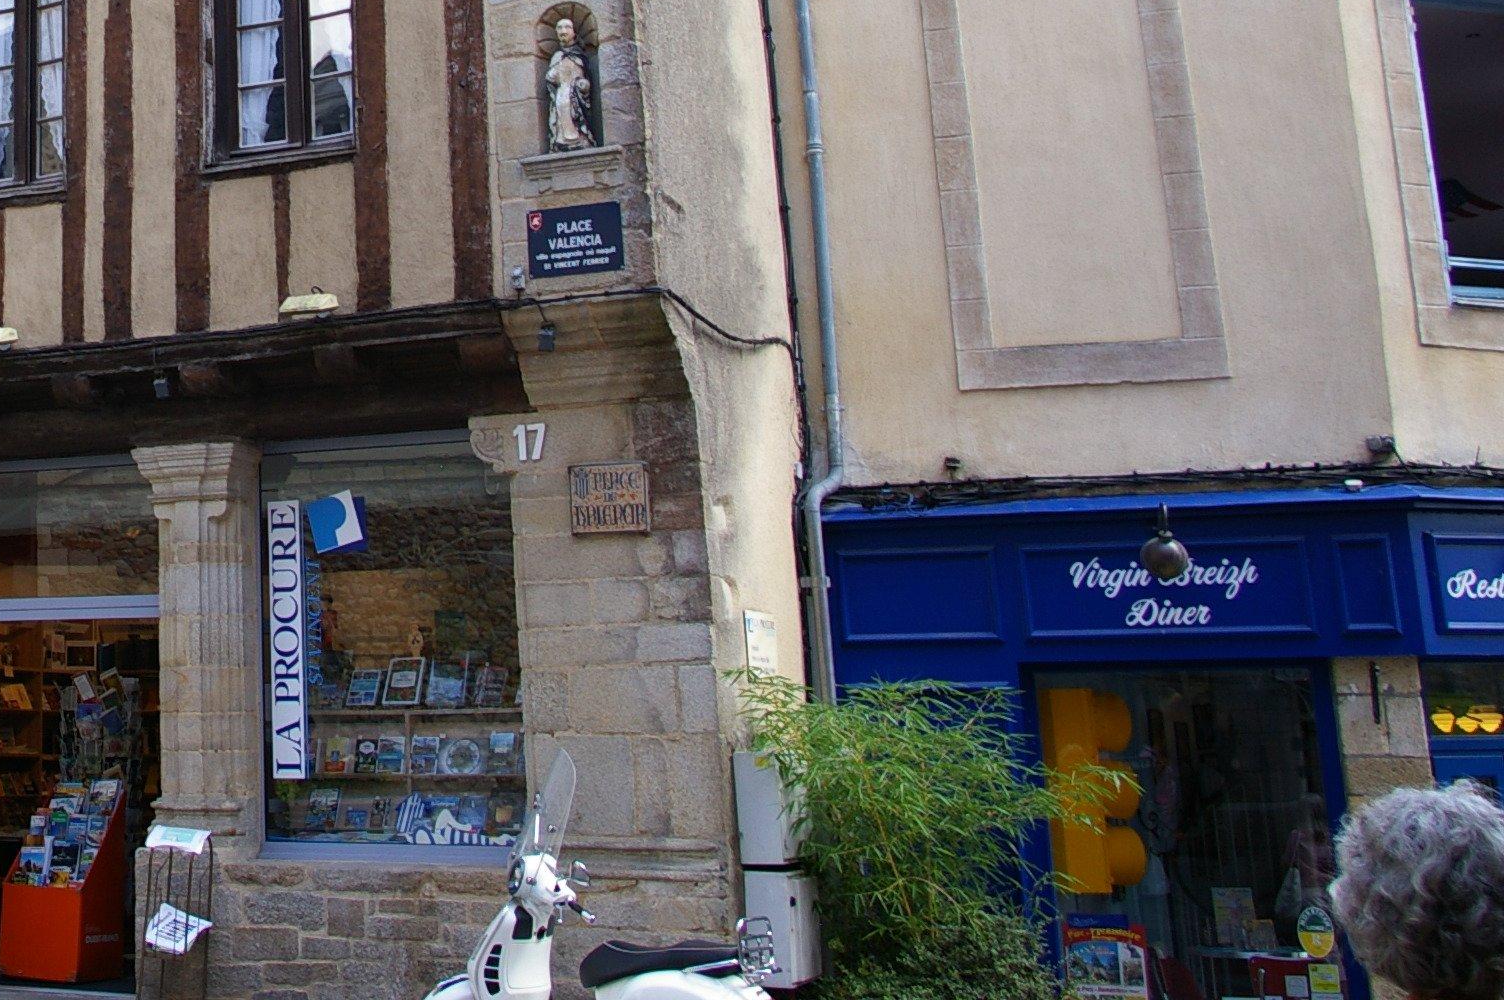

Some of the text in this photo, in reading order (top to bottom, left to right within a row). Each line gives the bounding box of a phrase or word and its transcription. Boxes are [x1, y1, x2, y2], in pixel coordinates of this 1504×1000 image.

[548, 234, 602, 250] VALENCIA
[556, 219, 593, 234] PLACE
[513, 423, 545, 461] 17
[1069, 556, 1152, 599] Virgin
[306, 558, 323, 657] VINCENT
[1125, 597, 1212, 627] Diner
[271, 503, 303, 775] LA PROCURE
